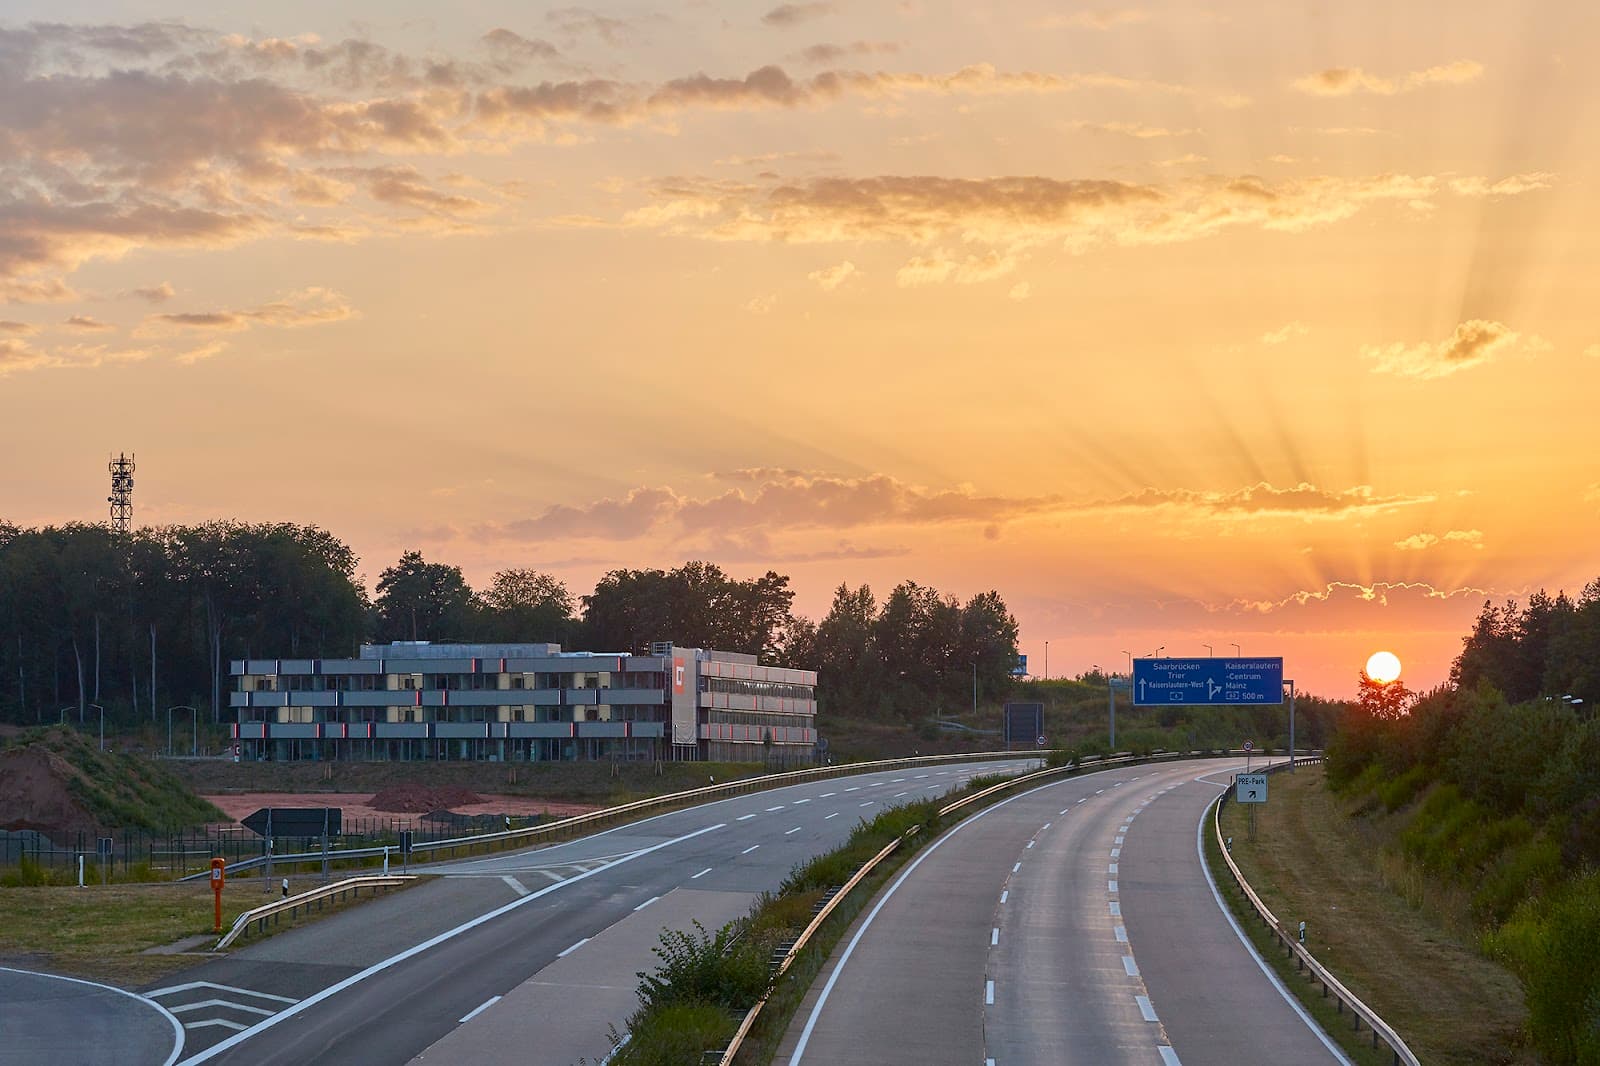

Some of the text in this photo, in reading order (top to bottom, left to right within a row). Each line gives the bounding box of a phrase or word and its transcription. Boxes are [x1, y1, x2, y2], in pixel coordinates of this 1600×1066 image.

[1153, 662, 1200, 670] Saarbrücken
[1225, 662, 1280, 670] Kaiserslautern
[1168, 671, 1185, 679] Trier
[1242, 692, 1255, 700] 500
[1238, 777, 1265, 785] PRE-Park
